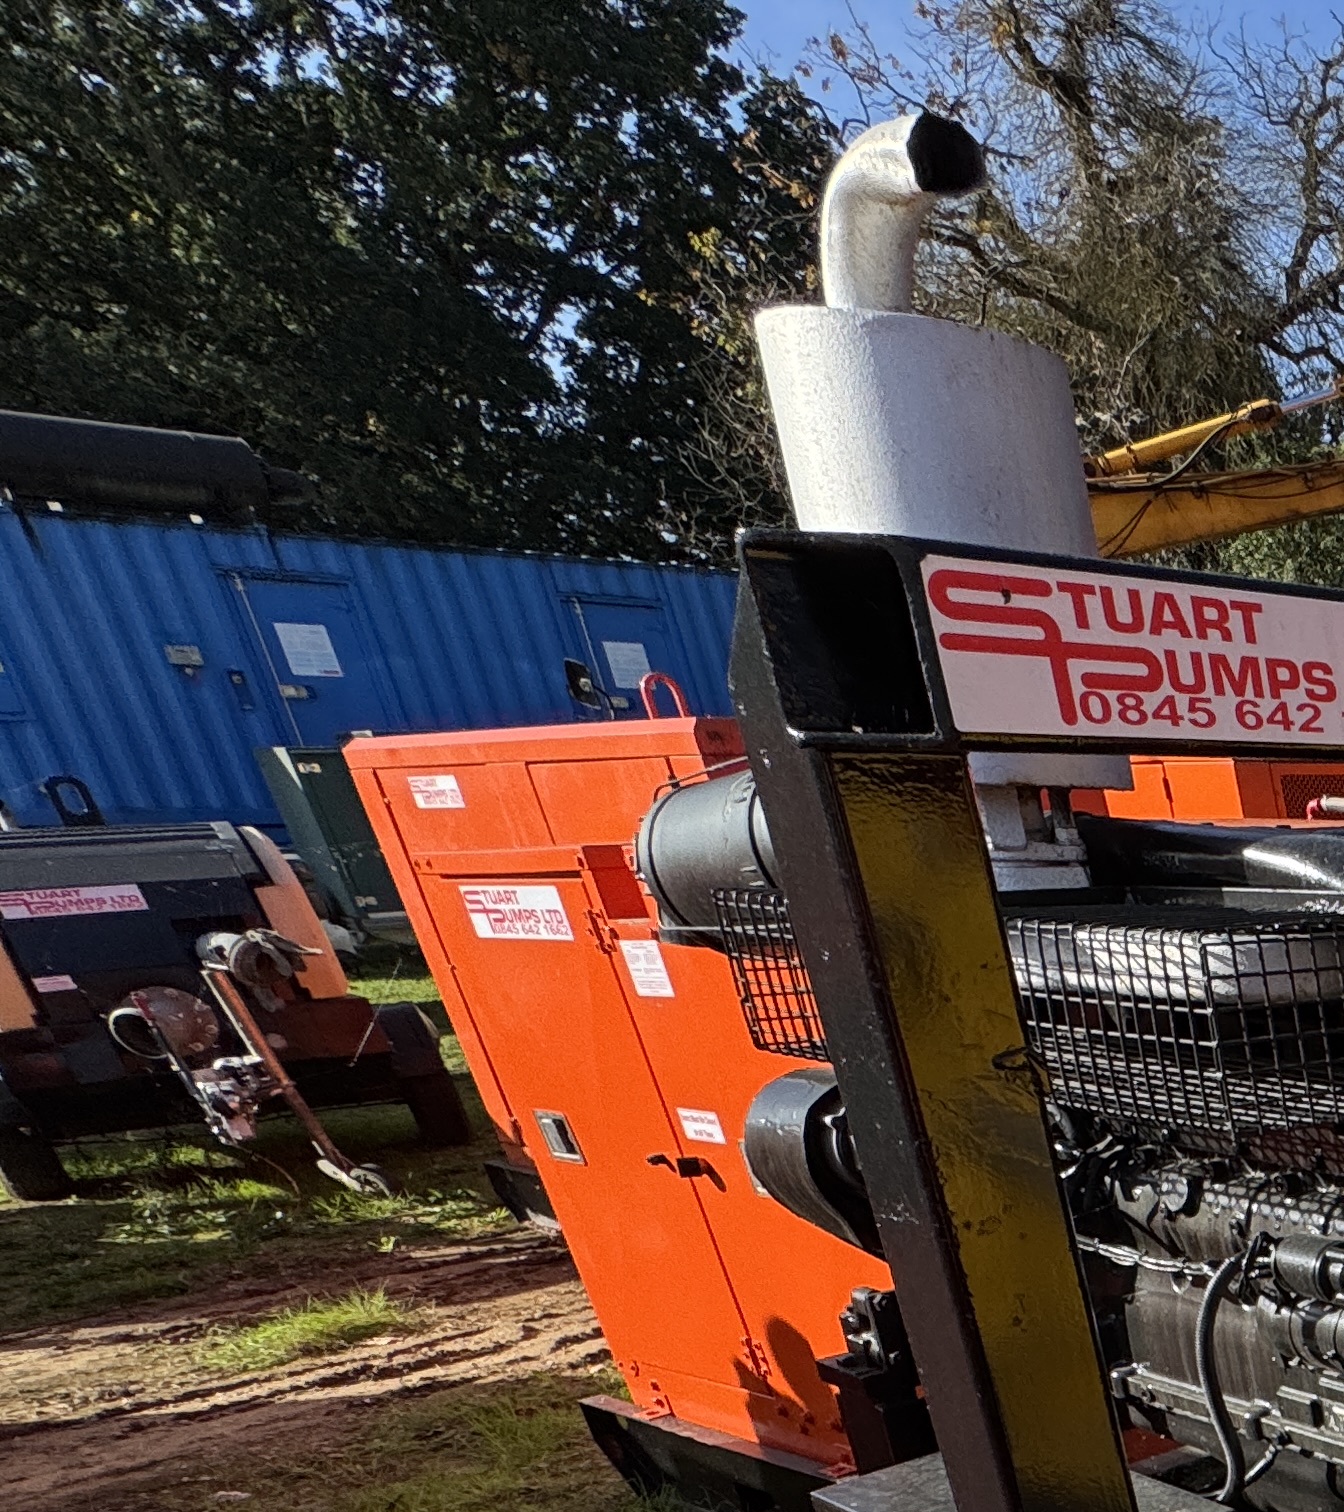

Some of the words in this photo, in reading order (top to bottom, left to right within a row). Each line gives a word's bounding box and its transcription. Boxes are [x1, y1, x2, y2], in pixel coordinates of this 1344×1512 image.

[928, 568, 1263, 645] STUART
[940, 632, 1338, 726] PUMPS
[1081, 690, 1217, 730] 0845
[1235, 699, 1326, 733] 642
[463, 890, 520, 906] STUART
[521, 923, 542, 936] 642
[540, 908, 565, 924] LTD
